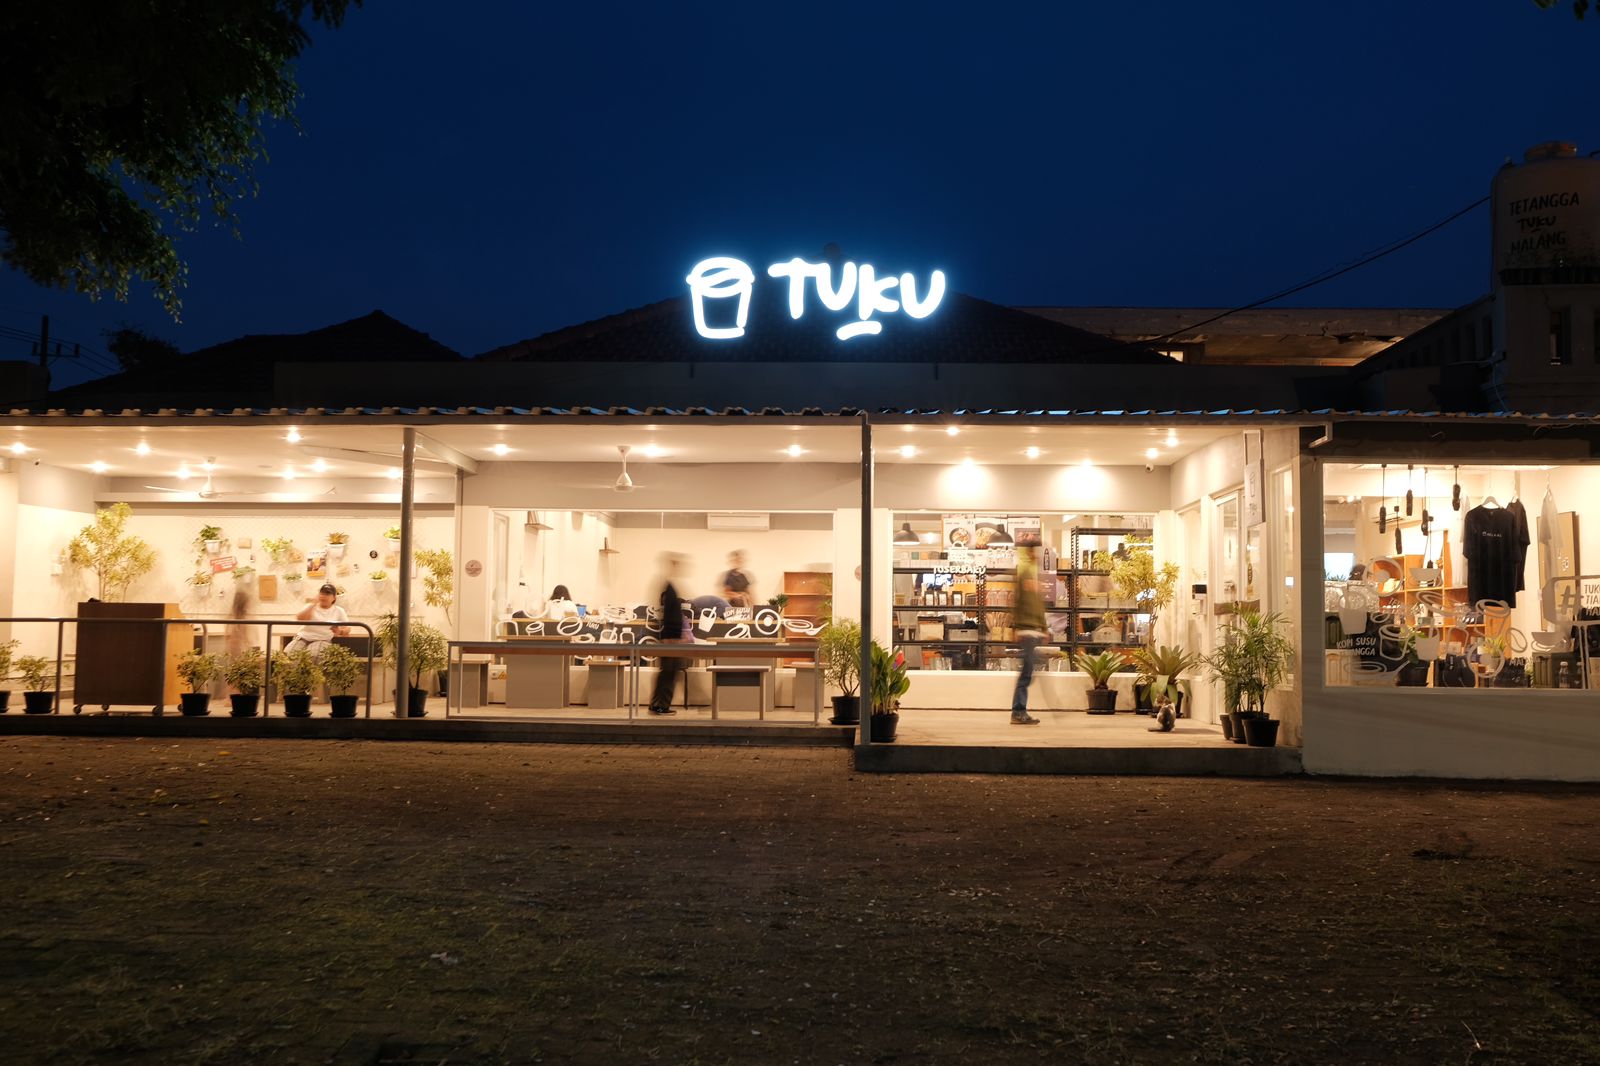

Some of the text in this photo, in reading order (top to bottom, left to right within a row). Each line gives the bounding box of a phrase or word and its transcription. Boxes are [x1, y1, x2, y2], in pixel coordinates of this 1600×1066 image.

[1509, 191, 1580, 216] TETANGGA
[1515, 216, 1557, 231] TUKU
[1510, 231, 1567, 255] MALANG
[768, 257, 946, 320] TUKU
[1584, 584, 1600, 594] TUK
[1586, 594, 1600, 605] TIA
[1355, 636, 1377, 646] SUSU
